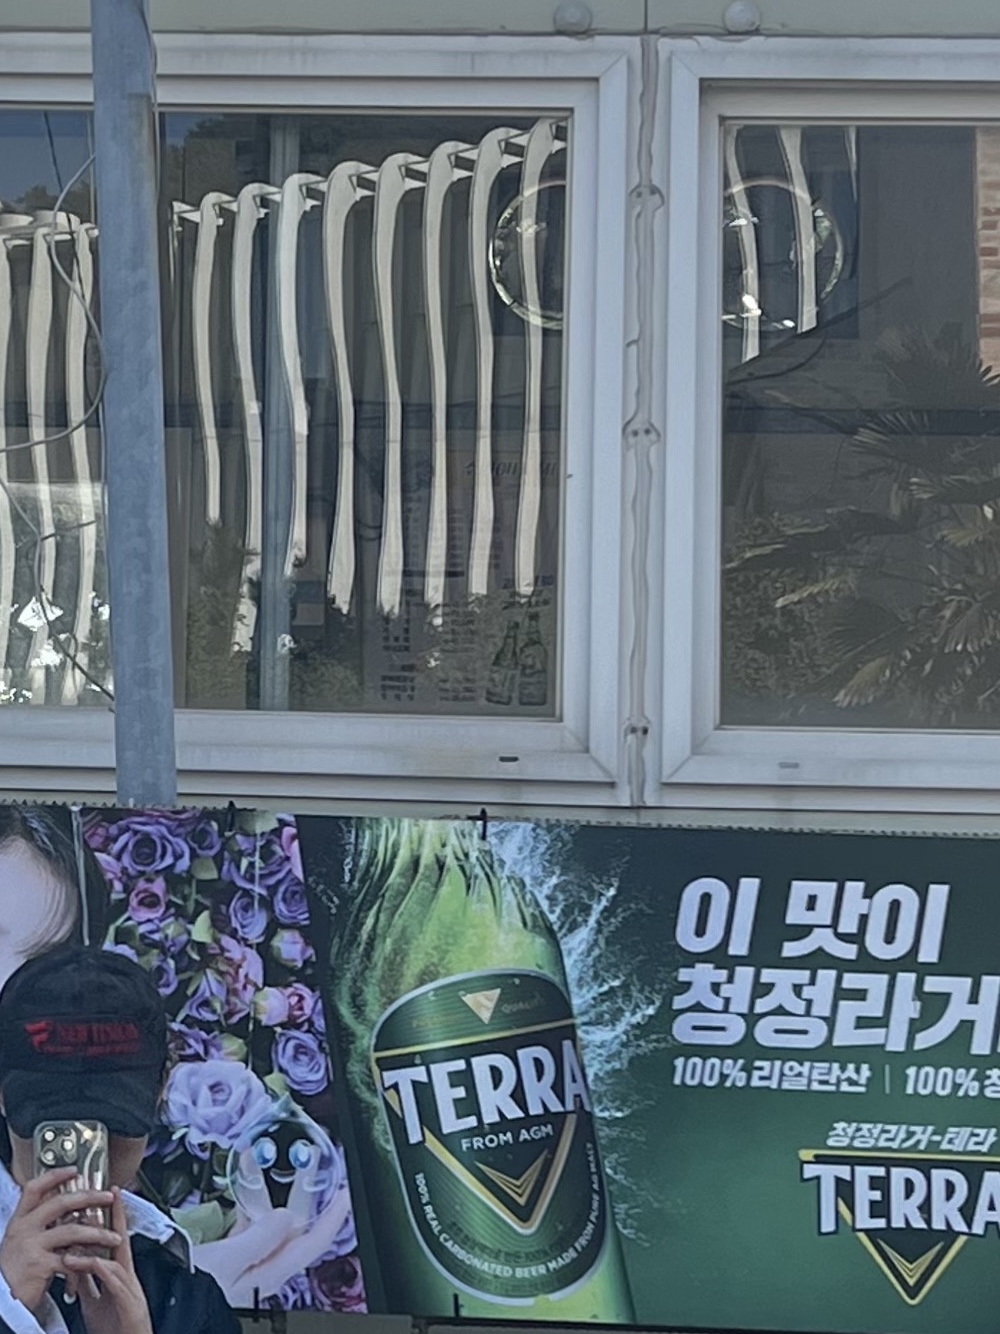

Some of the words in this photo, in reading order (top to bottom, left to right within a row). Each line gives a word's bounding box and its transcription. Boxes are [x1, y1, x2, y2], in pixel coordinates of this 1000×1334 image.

[675, 876, 761, 956] 이
[781, 880, 950, 964] 맛이
[671, 962, 1000, 1056] 청정라거
[382, 1039, 592, 1144] TERRA
[460, 1133, 514, 1152] FROM
[518, 1123, 554, 1142] AGM
[826, 1121, 997, 1153] 청정라거-테라
[414, 1172, 427, 1204] 100%
[423, 1205, 441, 1236] REAL
[439, 1233, 513, 1277] CARBONATED
[515, 1265, 547, 1278] BEER
[547, 1245, 578, 1273] MADE
[574, 1221, 596, 1252] FROM
[801, 1163, 1000, 1236] TERRA
